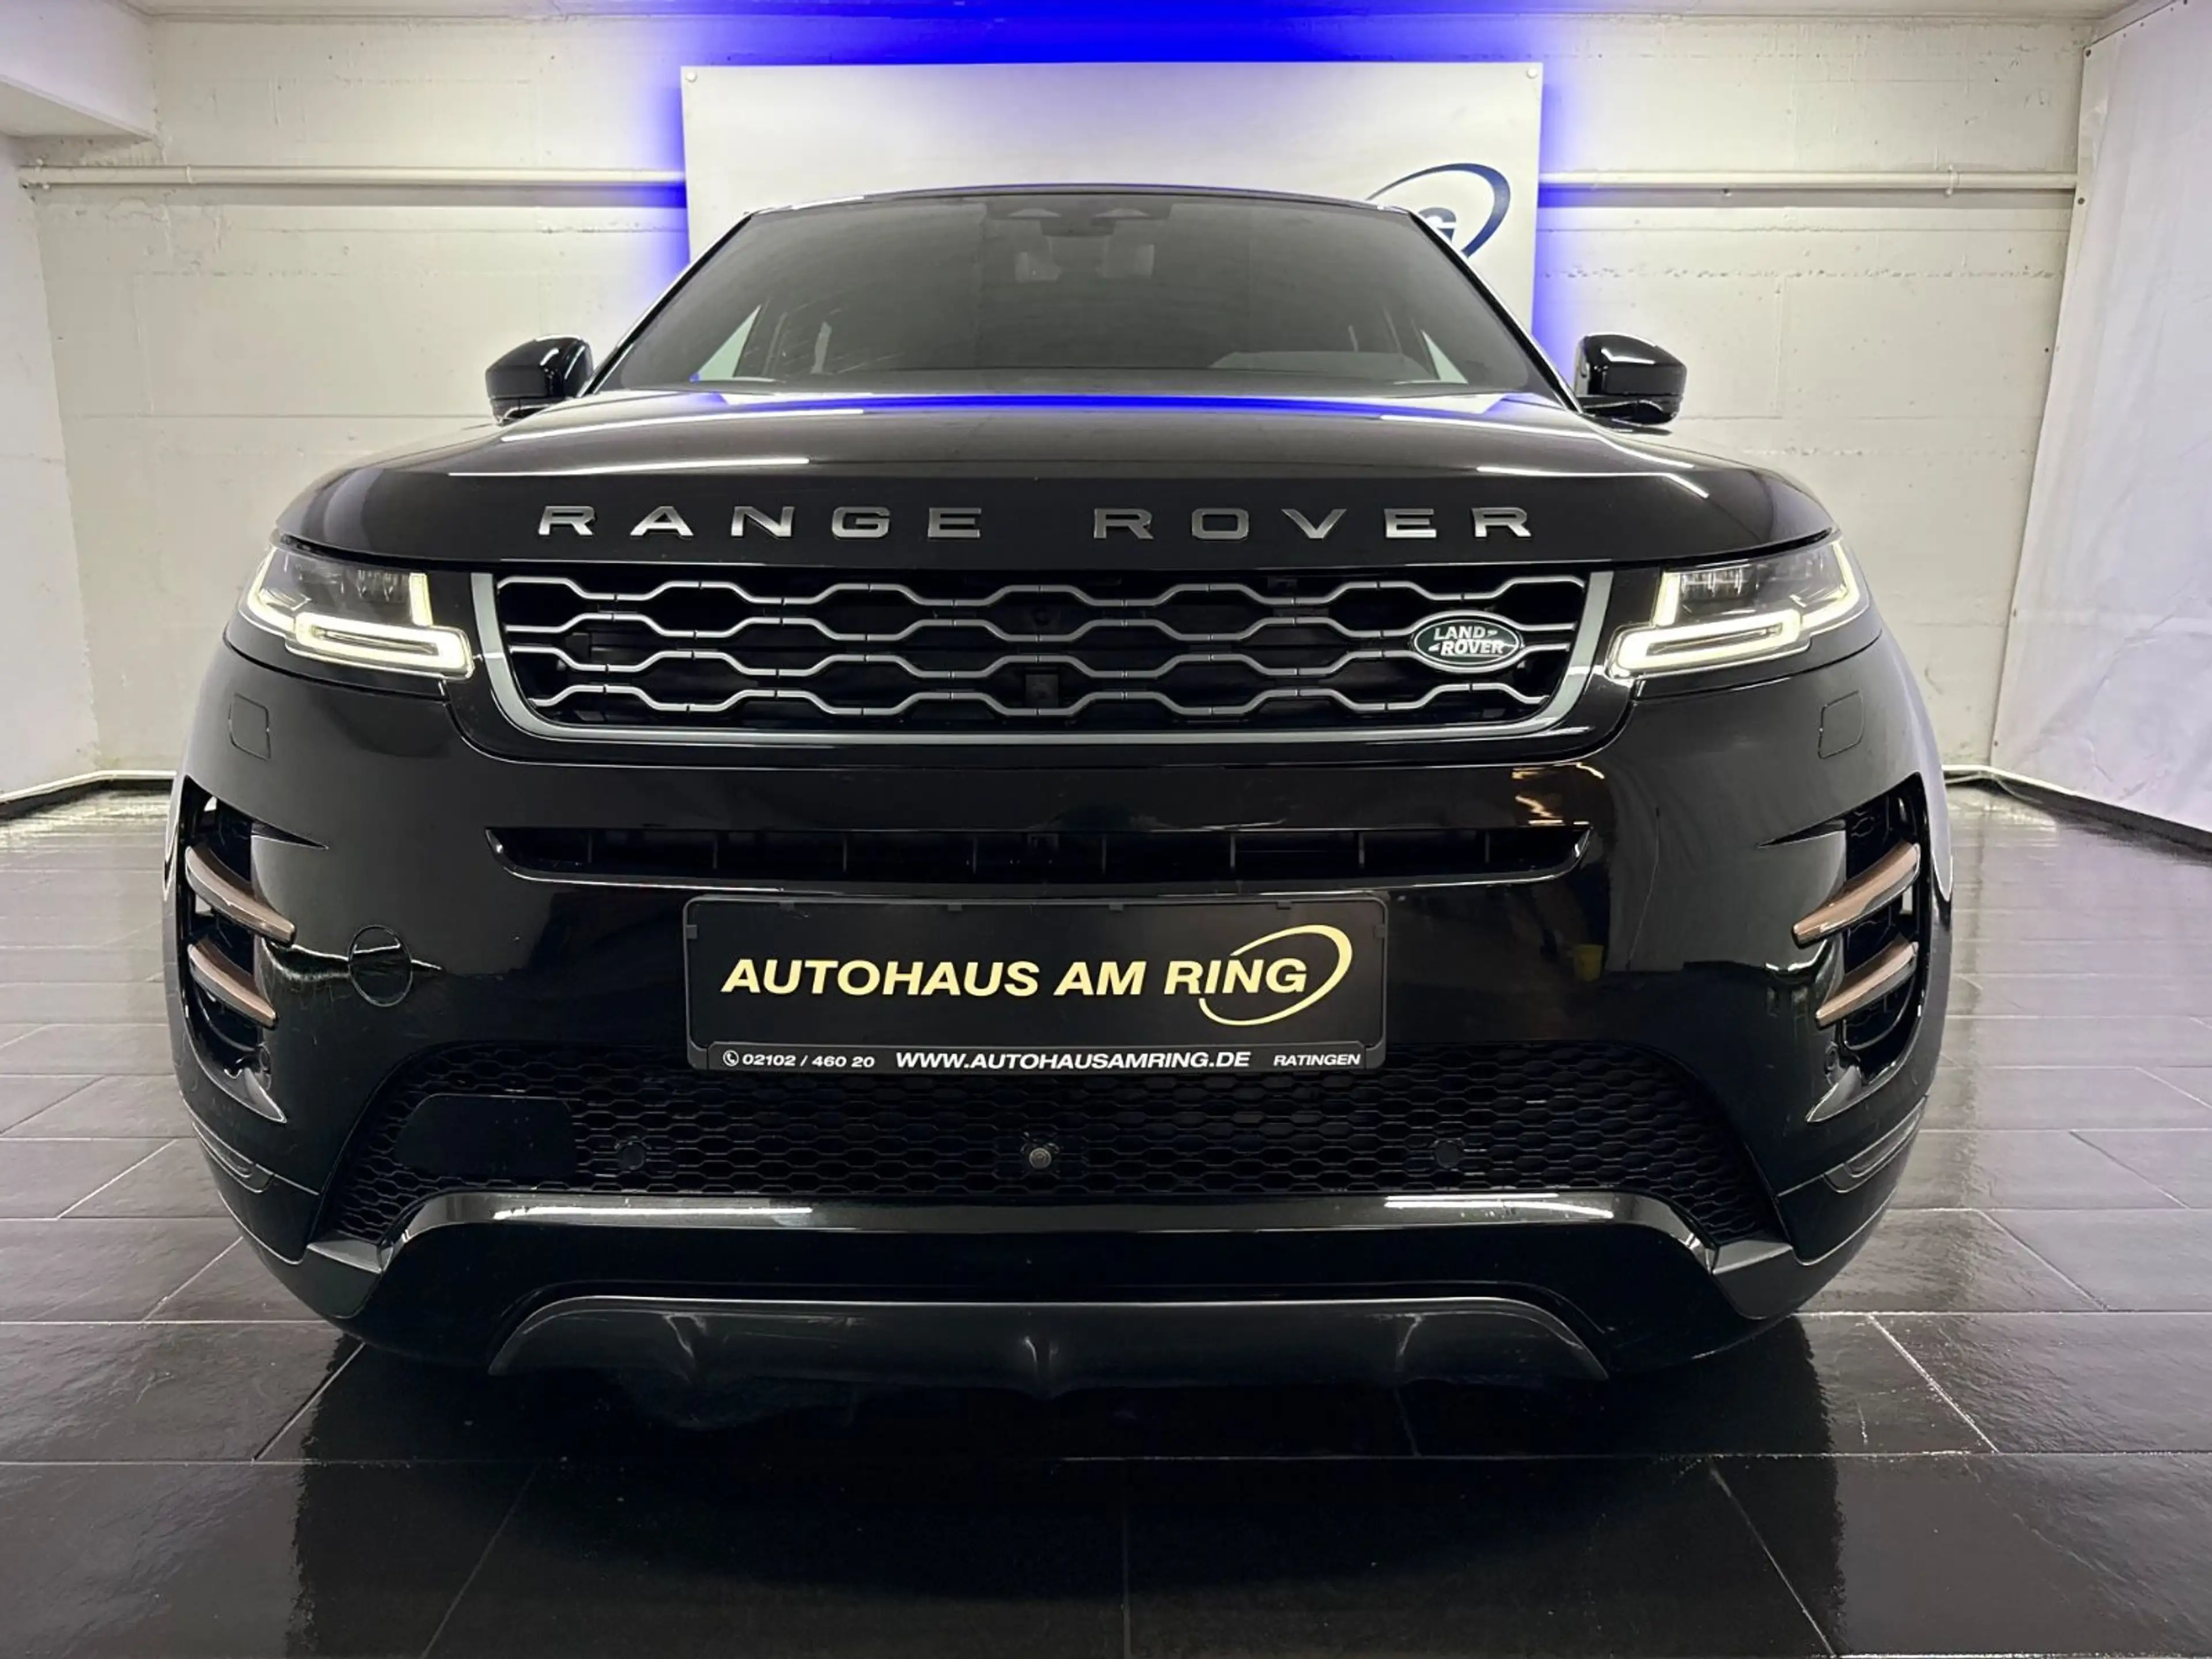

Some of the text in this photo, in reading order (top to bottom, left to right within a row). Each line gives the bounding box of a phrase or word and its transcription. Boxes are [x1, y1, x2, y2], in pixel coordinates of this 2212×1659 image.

[537, 505, 1532, 539] RANGE ROVER
[1433, 626, 1485, 641] LAND
[1440, 639, 1503, 656] ROVER
[721, 958, 1308, 997] AUTOHAUS AM RING
[742, 1051, 1361, 1070] 02102 / 460 20 WWW.AUTOHAUSAMRING.DE RATINGEN
